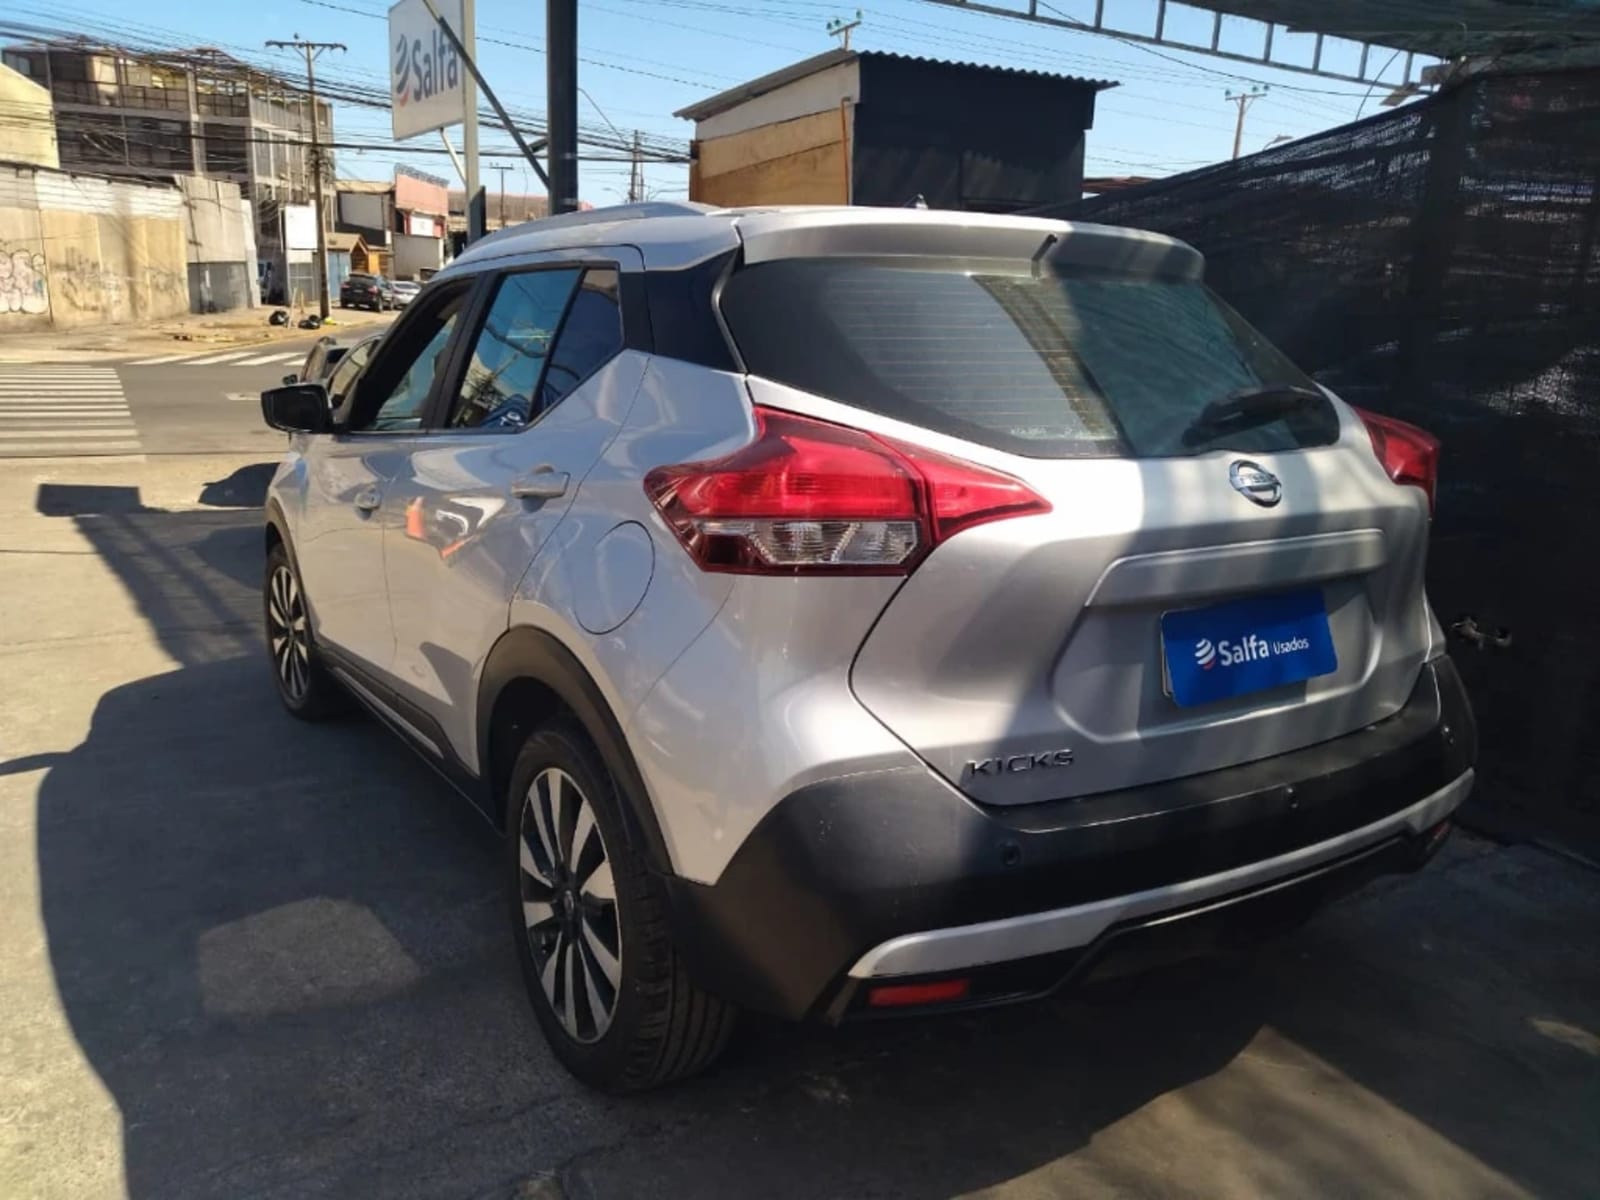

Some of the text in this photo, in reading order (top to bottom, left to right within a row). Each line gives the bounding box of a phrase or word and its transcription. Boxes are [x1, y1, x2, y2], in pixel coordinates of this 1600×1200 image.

[412, 29, 458, 102] Salfa
[1218, 634, 1309, 666] Salfa Usados
[965, 748, 1074, 776] KICKS
